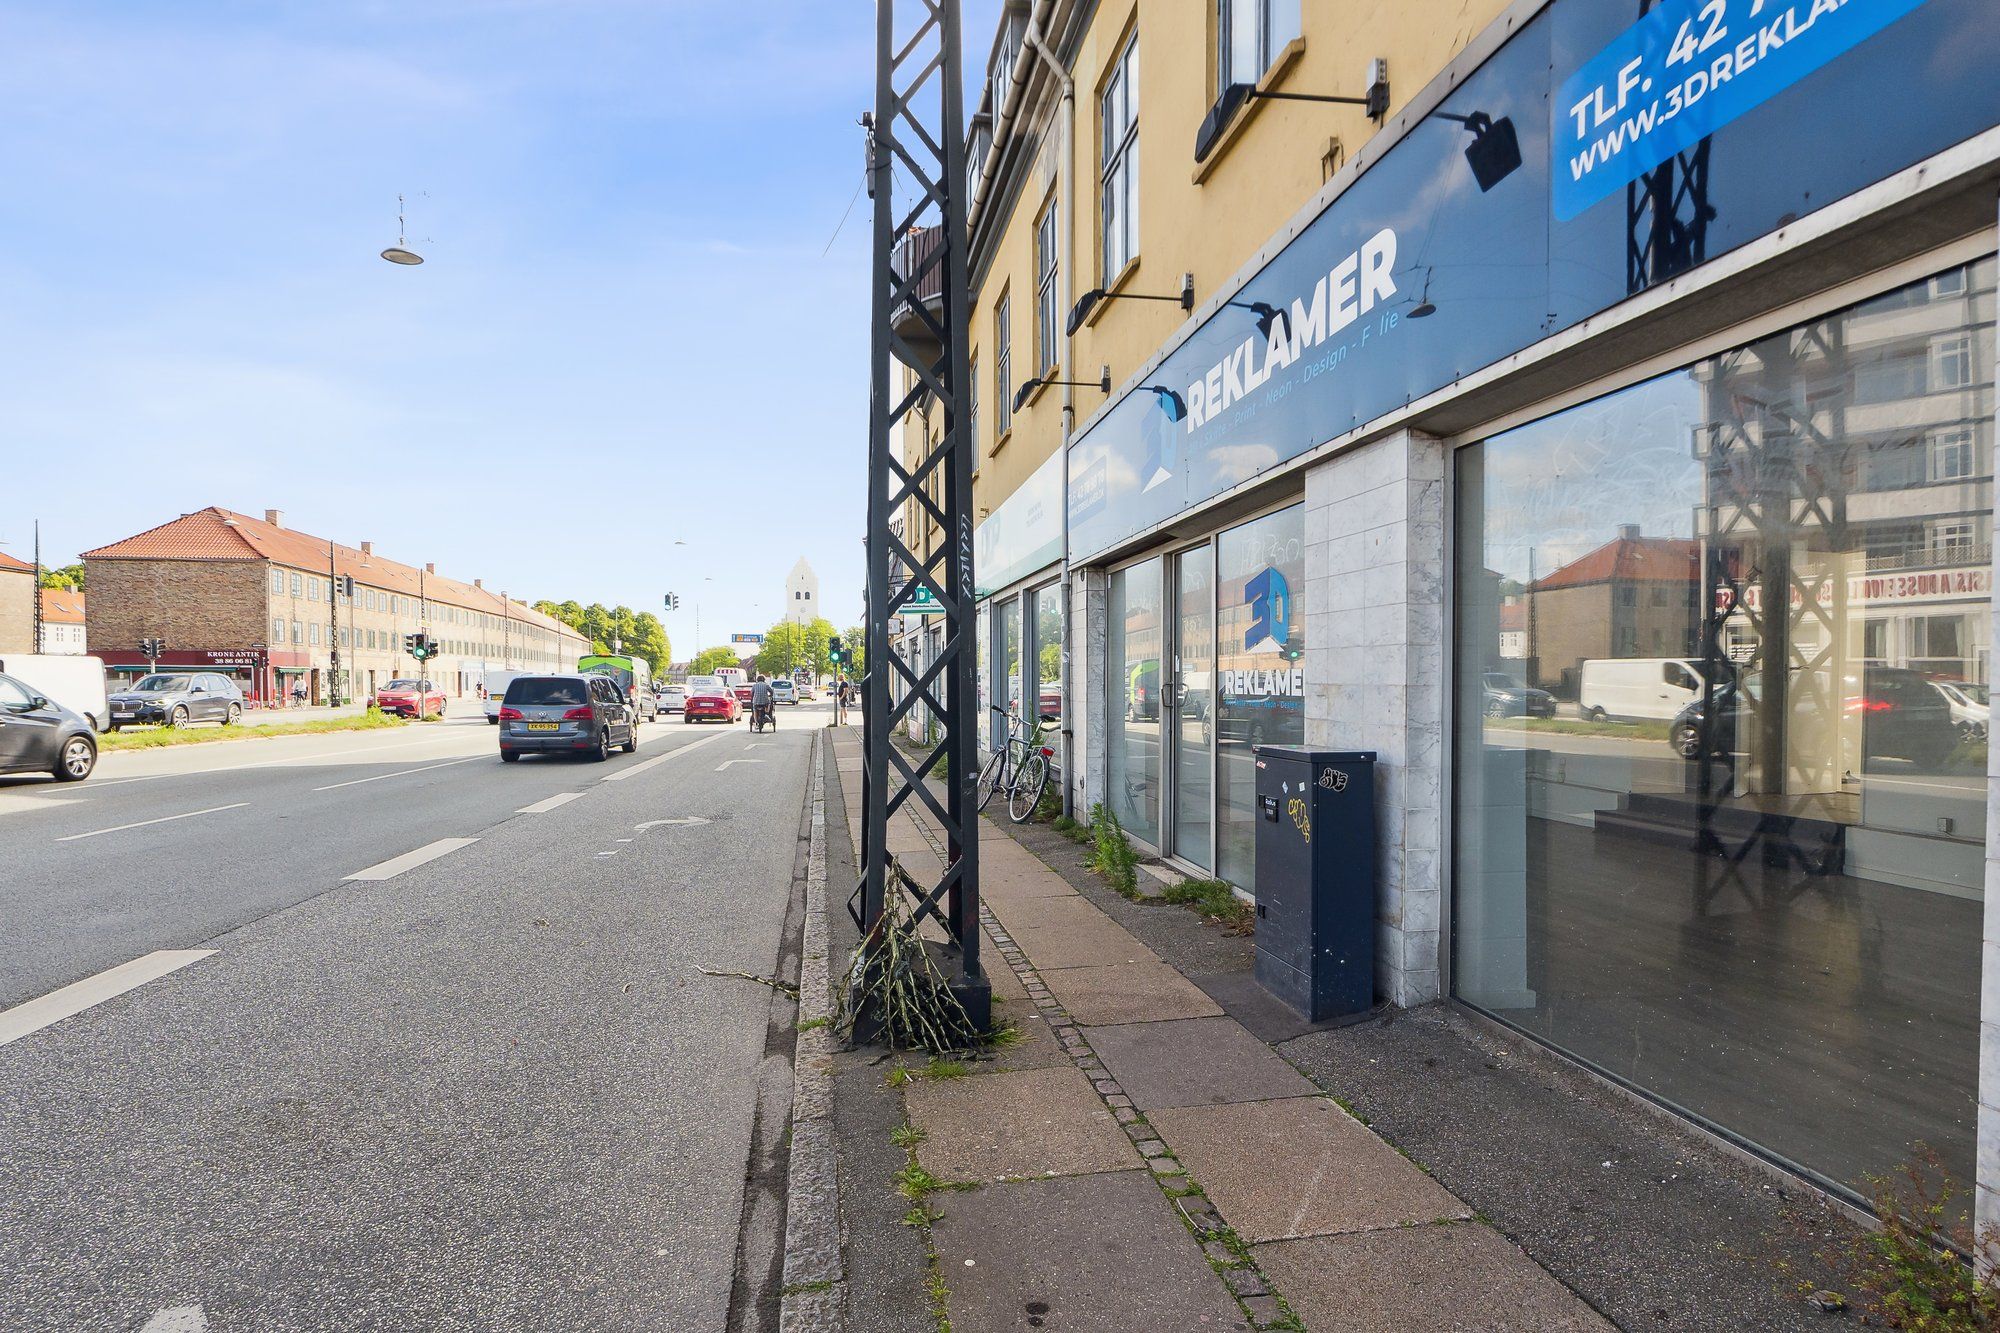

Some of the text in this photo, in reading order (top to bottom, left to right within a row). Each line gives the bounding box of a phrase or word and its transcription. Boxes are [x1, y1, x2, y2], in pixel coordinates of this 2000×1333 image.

[1569, 0, 1728, 141] TLF. 42
[1569, 0, 1853, 182] WWW.3DREKLA
[1187, 227, 1398, 434] REKLAMER
[1265, 378, 1293, 405] Neon
[1303, 345, 1347, 384] Design
